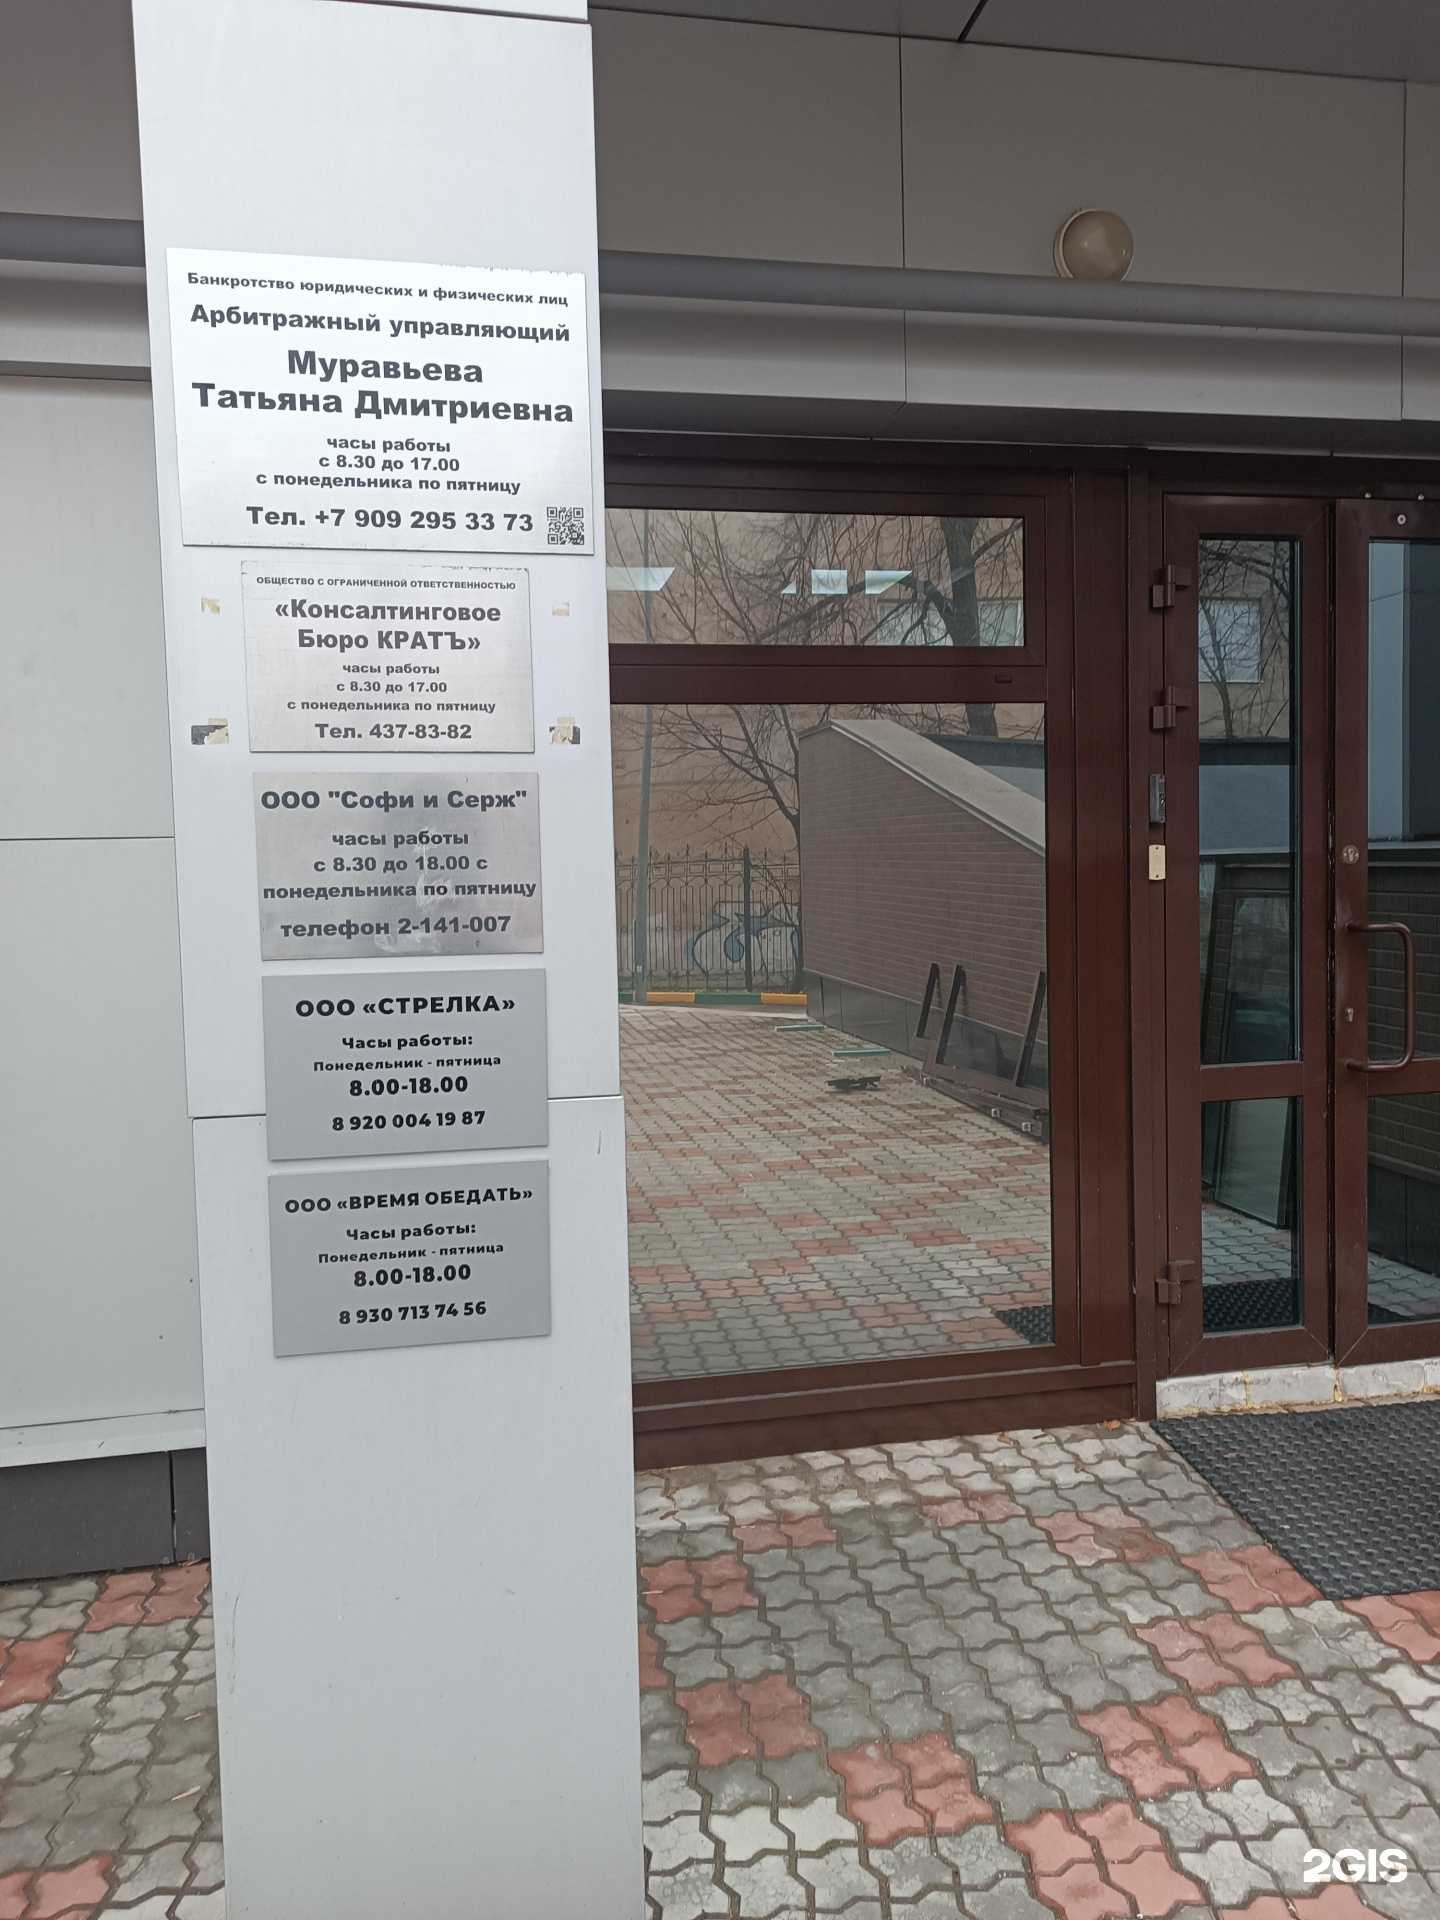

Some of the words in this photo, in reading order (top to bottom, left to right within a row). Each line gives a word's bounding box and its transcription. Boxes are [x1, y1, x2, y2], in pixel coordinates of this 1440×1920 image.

[188, 272, 294, 290] Банкротство
[300, 281, 413, 297] юридических
[419, 288, 428, 297] и
[433, 287, 533, 303] физических
[539, 294, 568, 307] лиц
[191, 305, 380, 333] Арбитражный
[389, 317, 570, 343] управляющий
[288, 350, 483, 383] Муравьева
[192, 383, 342, 413] Татьяна
[355, 391, 573, 423] Дмитриевна
[327, 437, 376, 450] часы
[383, 438, 450, 453] работы
[319, 457, 329, 468] с
[336, 455, 375, 469] 8.30
[381, 459, 404, 473] до
[410, 458, 459, 472] 17.00
[256, 474, 267, 484] с
[274, 474, 412, 489] понедельника
[419, 479, 440, 490] по
[446, 480, 520, 495] пятницу
[246, 506, 305, 526] Тел.
[315, 509, 345, 526] +7
[355, 509, 401, 528] 909
[410, 511, 456, 530] 295
[465, 513, 495, 530] 33
[504, 514, 533, 531] 73
[256, 576, 314, 586] ОБЩЕСТВО
[327, 578, 407, 588] ОГРАНИЧЕННОЙ
[410, 581, 516, 590] ОТВЕТСТВЕННОСТЬЮ
[276, 599, 501, 621] «Консалтинговое
[298, 629, 368, 652] Бюро
[378, 631, 480, 650] КРАТЪ»
[343, 664, 381, 674] часы
[386, 663, 439, 676] работы
[337, 683, 344, 691] с
[350, 681, 381, 692] 8.30
[386, 684, 403, 694] до
[408, 682, 447, 692] 17.00
[288, 702, 296, 710] с
[301, 701, 410, 712] понедельника
[414, 702, 432, 711] по
[437, 702, 495, 713] пятницу
[315, 724, 362, 738] Тел.
[369, 724, 472, 739] 437-83-82
[261, 791, 320, 809] ООО
[328, 791, 414, 812] "Софи
[424, 794, 438, 808] и
[448, 790, 527, 812] Серж"
[332, 833, 386, 846] часы
[394, 831, 468, 848] работы
[314, 860, 326, 872] с
[333, 857, 376, 872] 8.30
[383, 859, 407, 874] до
[415, 856, 469, 870] 18.00
[476, 858, 488, 869] с
[263, 884, 417, 900] понедельника
[424, 885, 448, 896] по
[455, 882, 536, 897] пятницу
[281, 920, 390, 939] телефон
[398, 916, 511, 934] 2-141-007
[296, 999, 354, 1017] ООО
[363, 996, 515, 1014] «СТРЕЛКА»
[342, 1037, 392, 1048] Часы
[397, 1034, 472, 1050] работы:
[314, 1058, 423, 1072] Понедельник
[436, 1056, 501, 1068] пятница
[350, 1076, 468, 1096] 8.00-18.00
[332, 1117, 344, 1130] 8
[350, 1115, 386, 1130] 920
[393, 1113, 431, 1128] 004
[436, 1112, 456, 1126] 19
[462, 1111, 486, 1125] 87
[285, 1198, 331, 1213] ООО
[338, 1193, 419, 1210] «ВРЕМЯ
[425, 1187, 532, 1206] ОБЕДАТЬ»
[346, 1228, 395, 1240] Часы
[400, 1224, 476, 1240] работы:
[318, 1248, 426, 1264] Понедельник
[440, 1244, 504, 1256] пятница
[354, 1264, 471, 1286] 8.00-18.00
[339, 1311, 350, 1324] 8
[356, 1308, 392, 1323] 930
[398, 1304, 430, 1320] 713
[435, 1304, 458, 1317] 74
[464, 1301, 486, 1316] 56
